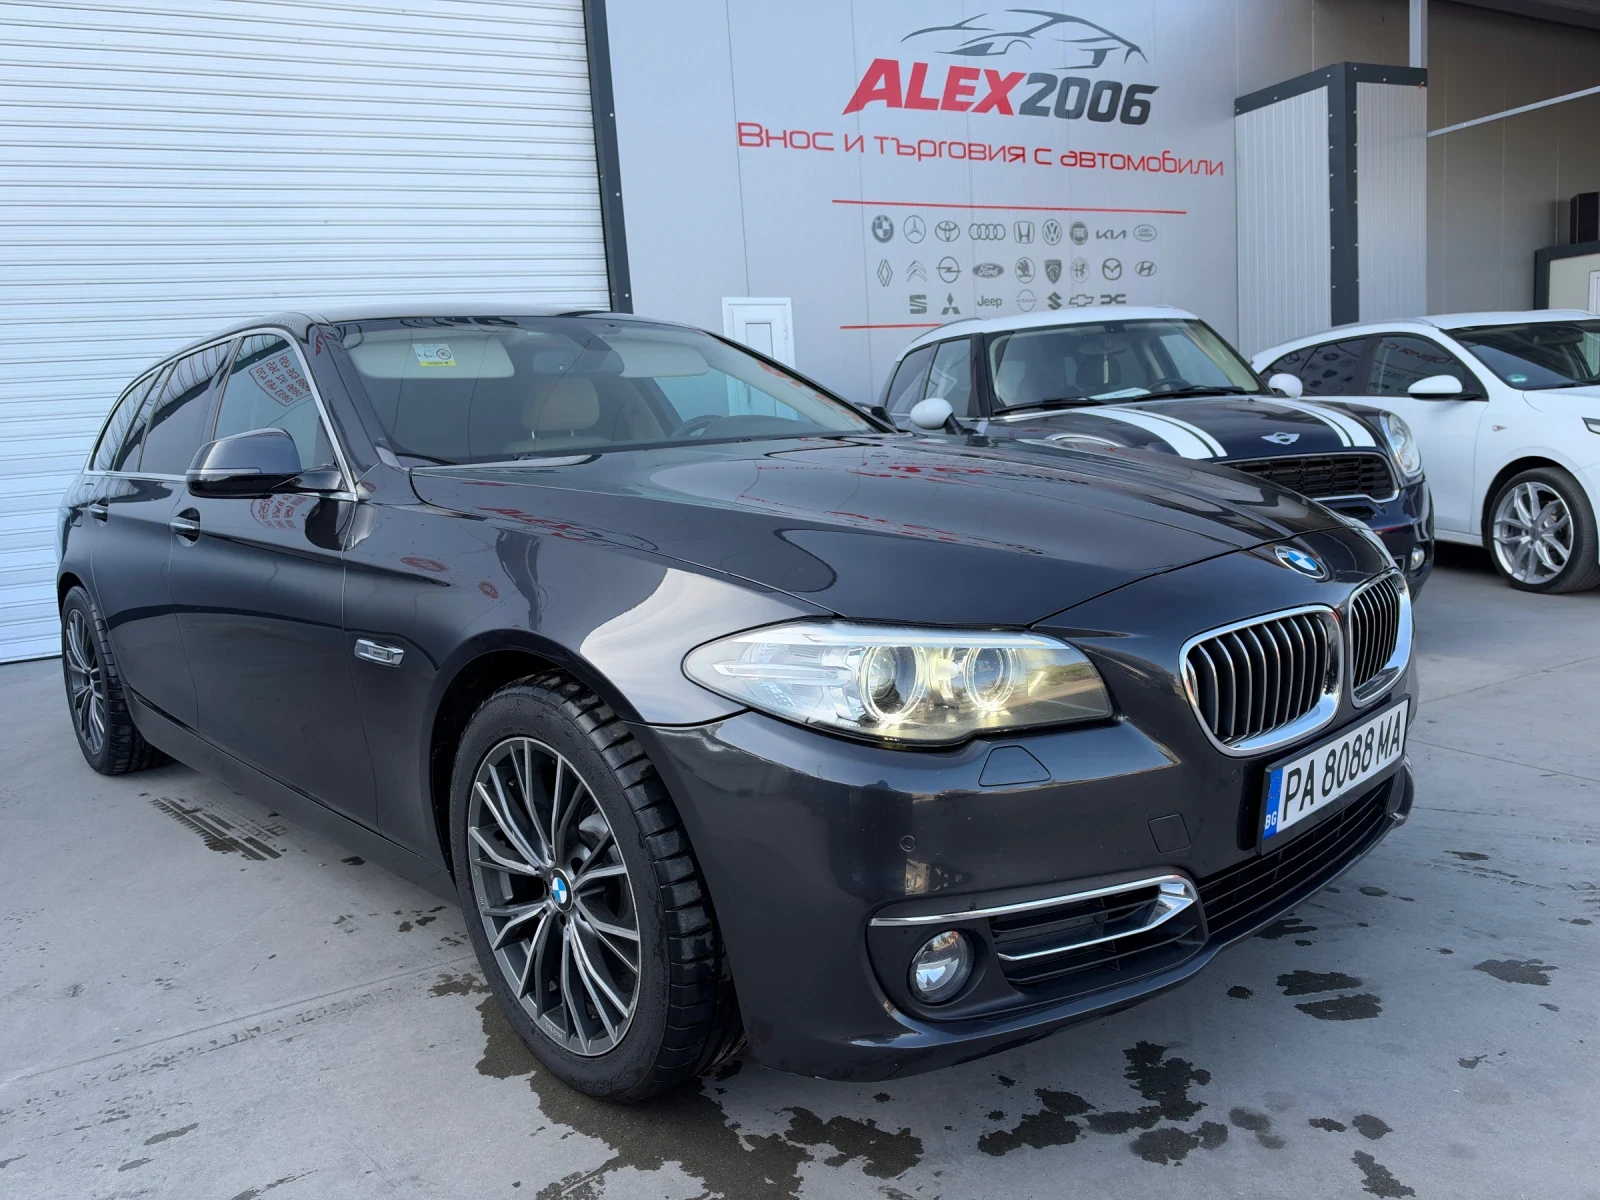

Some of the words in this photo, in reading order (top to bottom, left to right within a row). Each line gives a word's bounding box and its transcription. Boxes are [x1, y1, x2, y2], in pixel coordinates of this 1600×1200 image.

[842, 58, 1160, 125] ALEX2006
[737, 122, 834, 151] Внос
[844, 133, 865, 153] и
[873, 136, 1026, 163] търговия
[1034, 148, 1052, 165] с
[1060, 150, 1224, 176] автомобили
[977, 295, 1003, 308] Jeep
[1282, 758, 1315, 823] PA
[1321, 726, 1375, 798] 8088
[1376, 710, 1401, 765] MA
[1264, 811, 1278, 830] BG
